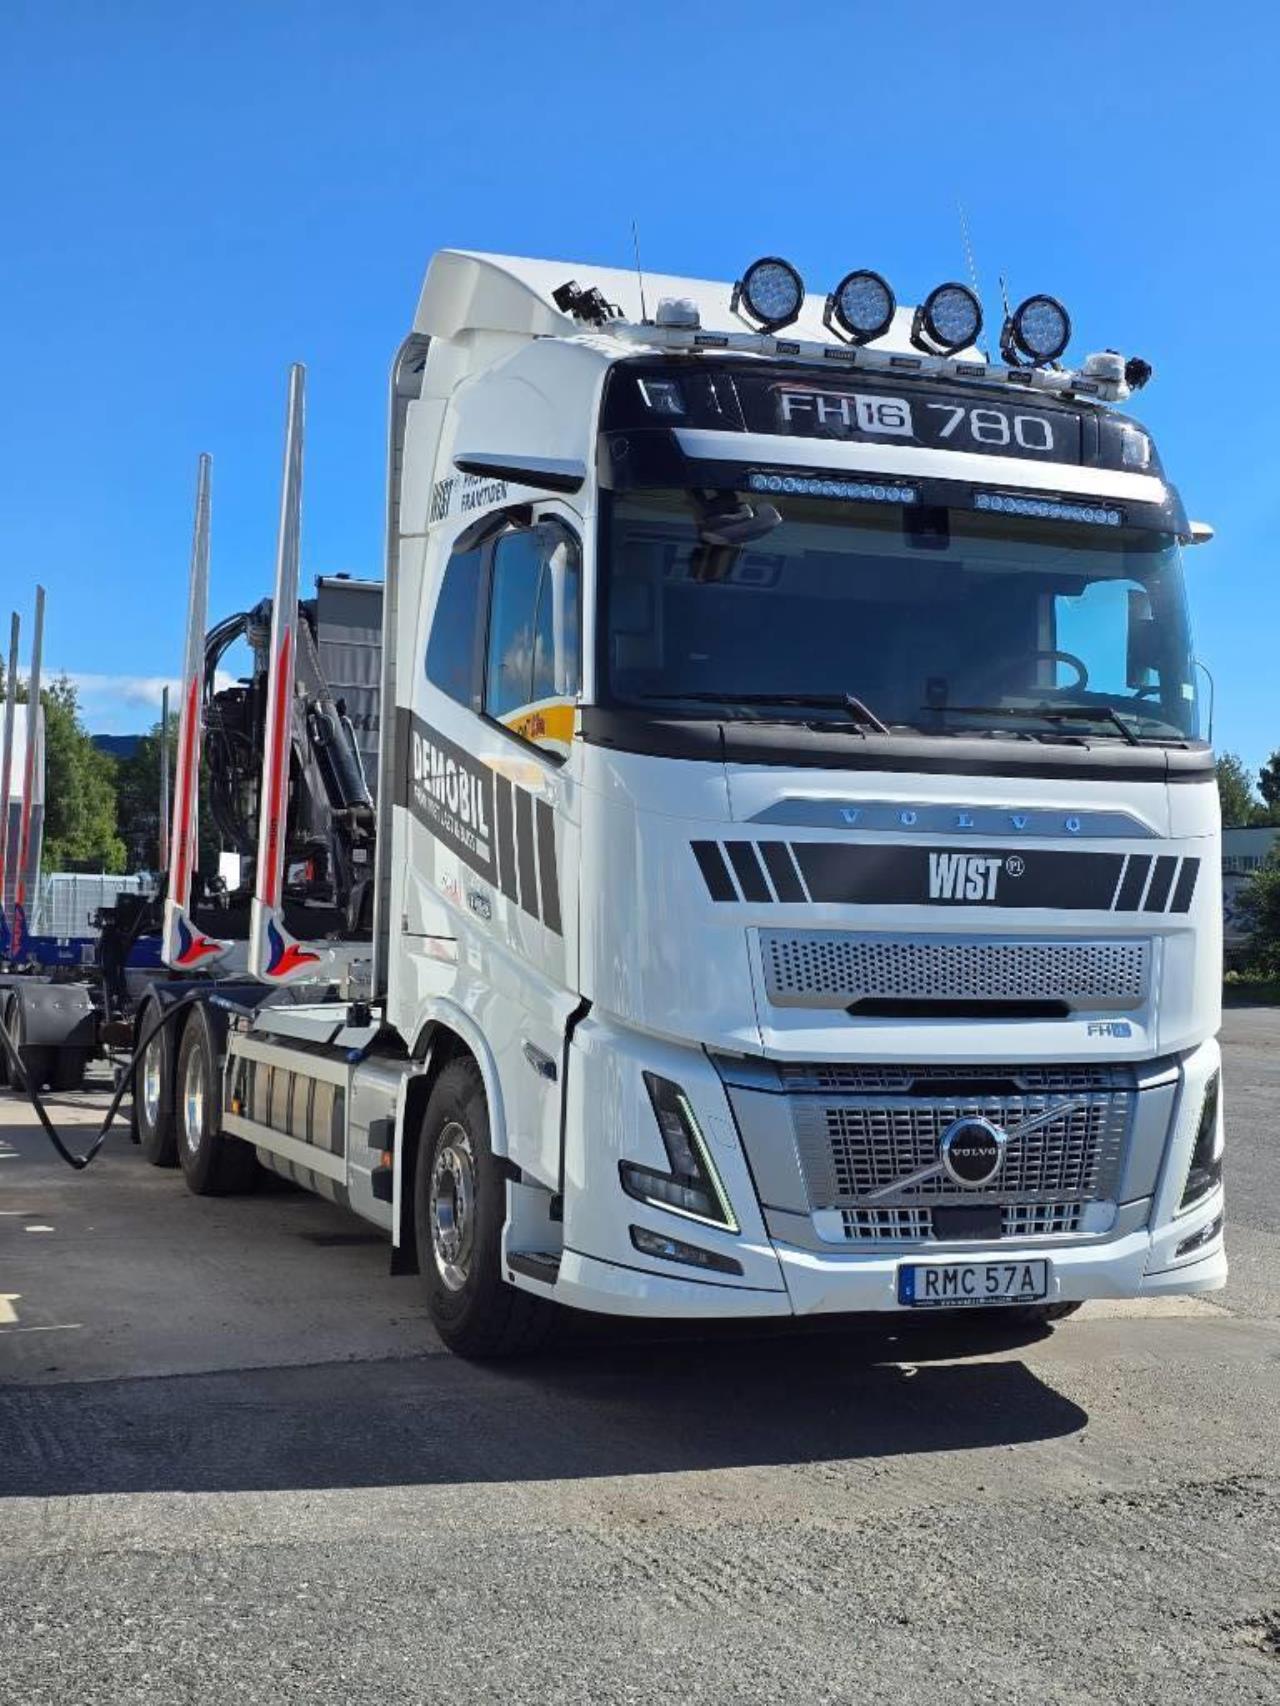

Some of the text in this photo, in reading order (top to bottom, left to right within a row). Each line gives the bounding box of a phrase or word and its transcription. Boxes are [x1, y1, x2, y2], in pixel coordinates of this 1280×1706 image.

[780, 391, 1054, 450] FH16 780
[413, 730, 489, 839] DEMOBIL
[840, 808, 1081, 832] VOLVO
[929, 852, 1003, 900] WIST
[951, 1147, 996, 1157] VOLVO
[925, 1265, 1035, 1297] RMC 57A
